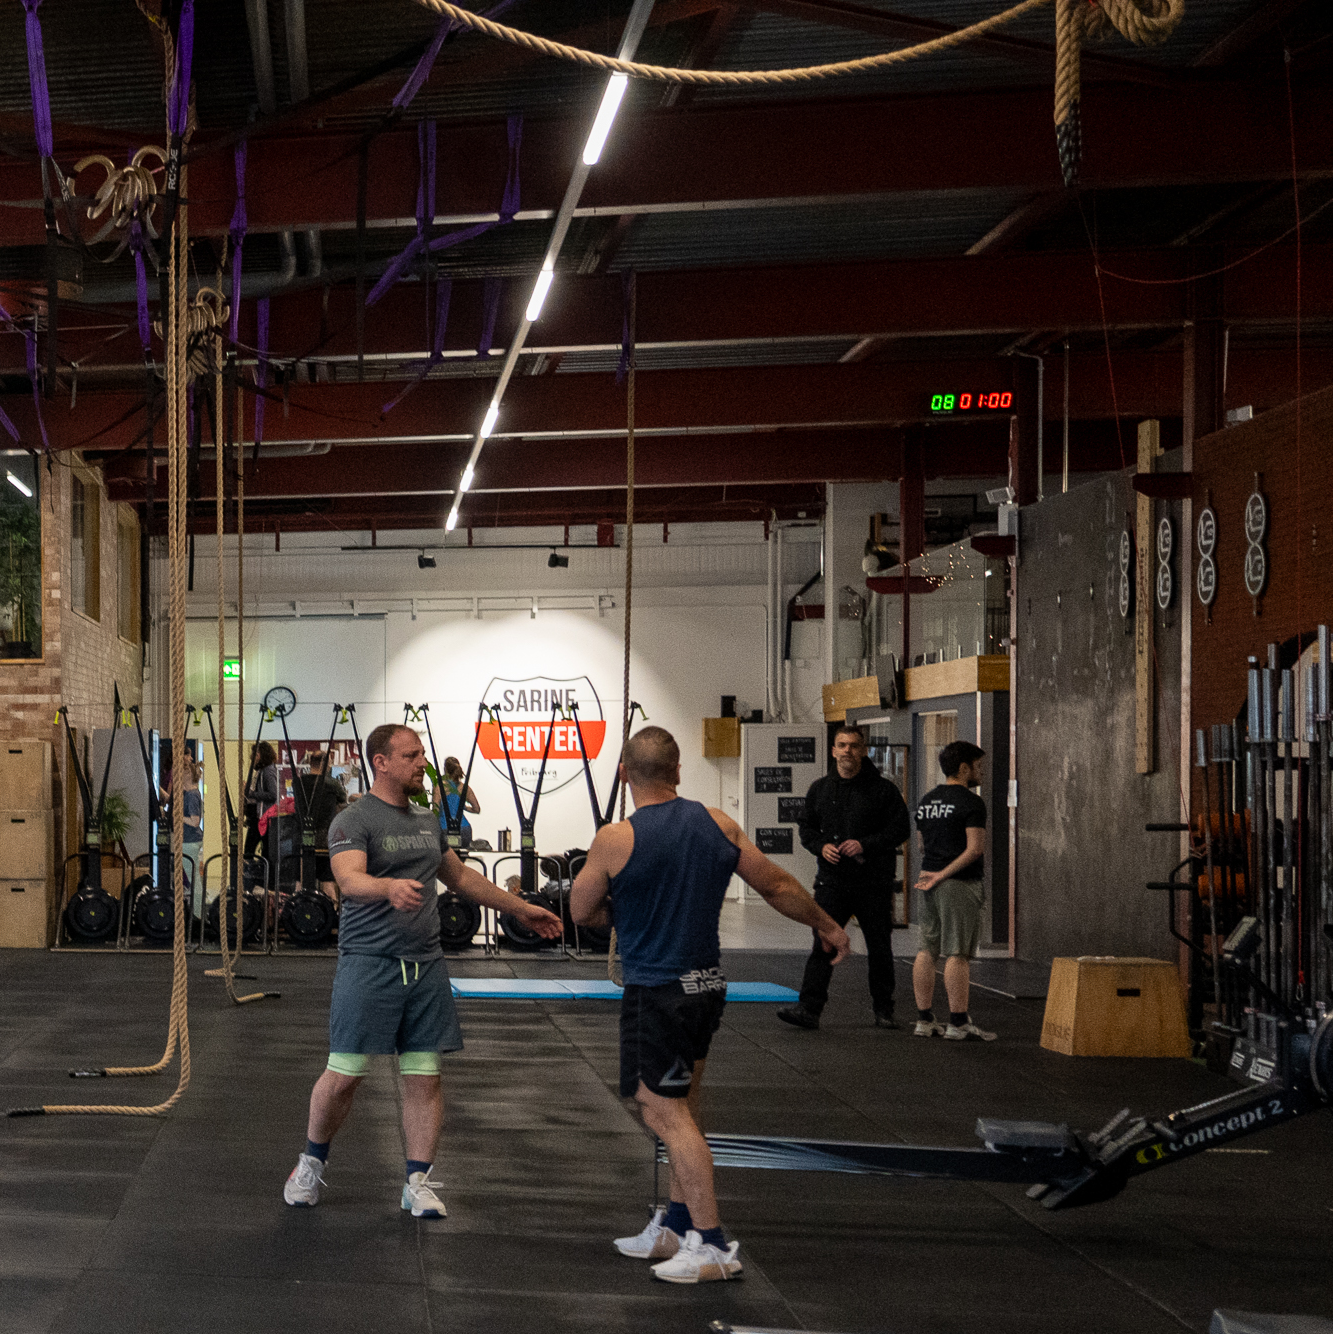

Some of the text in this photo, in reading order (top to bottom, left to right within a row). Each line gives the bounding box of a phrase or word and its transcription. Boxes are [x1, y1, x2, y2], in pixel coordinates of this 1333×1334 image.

[931, 394, 955, 410] 08
[503, 689, 576, 712] SARINE
[498, 726, 582, 752] CENTER
[917, 804, 955, 820] STAFF
[1268, 1099, 1283, 1115] 2
